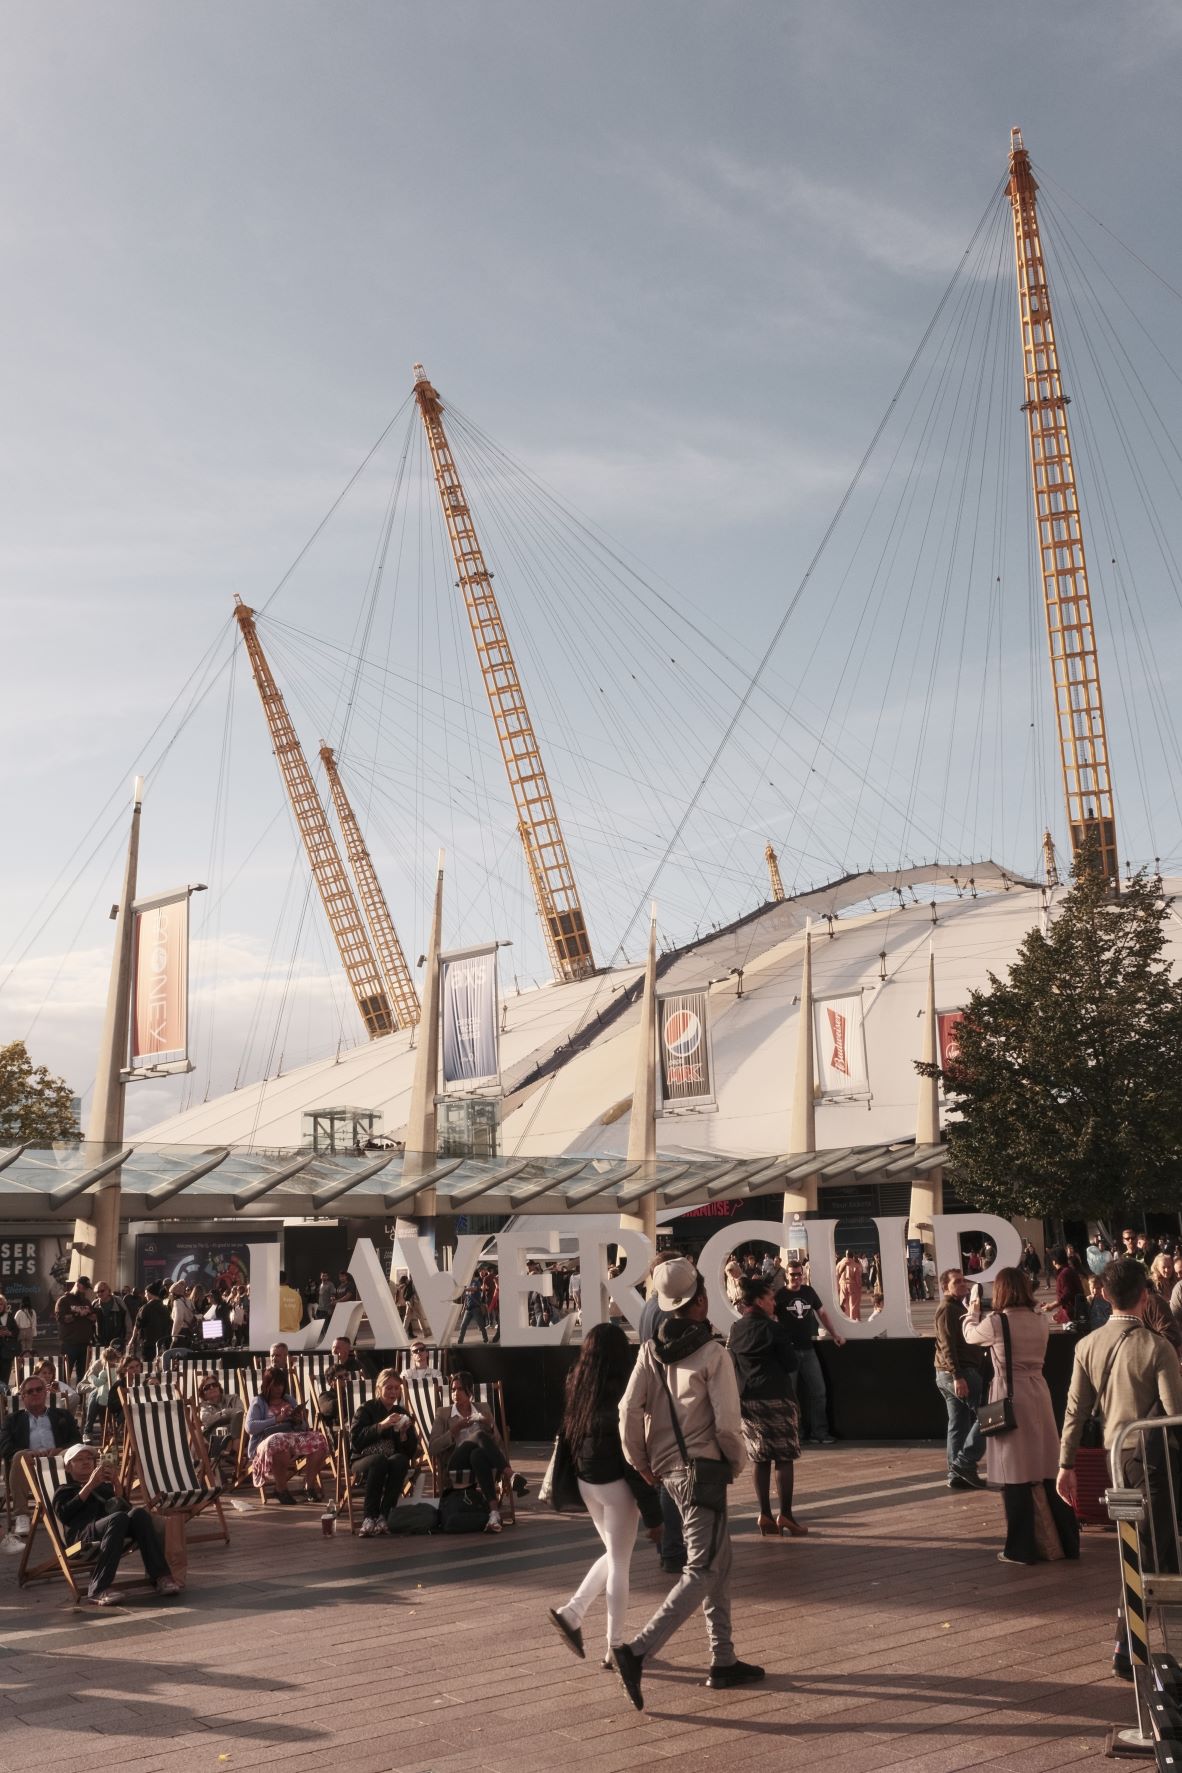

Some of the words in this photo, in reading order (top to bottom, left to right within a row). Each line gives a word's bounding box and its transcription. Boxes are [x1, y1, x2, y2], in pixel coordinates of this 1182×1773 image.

[833, 1013, 846, 1071] Budweiser
[248, 1229, 656, 1350] LAVER
[697, 1213, 1022, 1340] CUP
